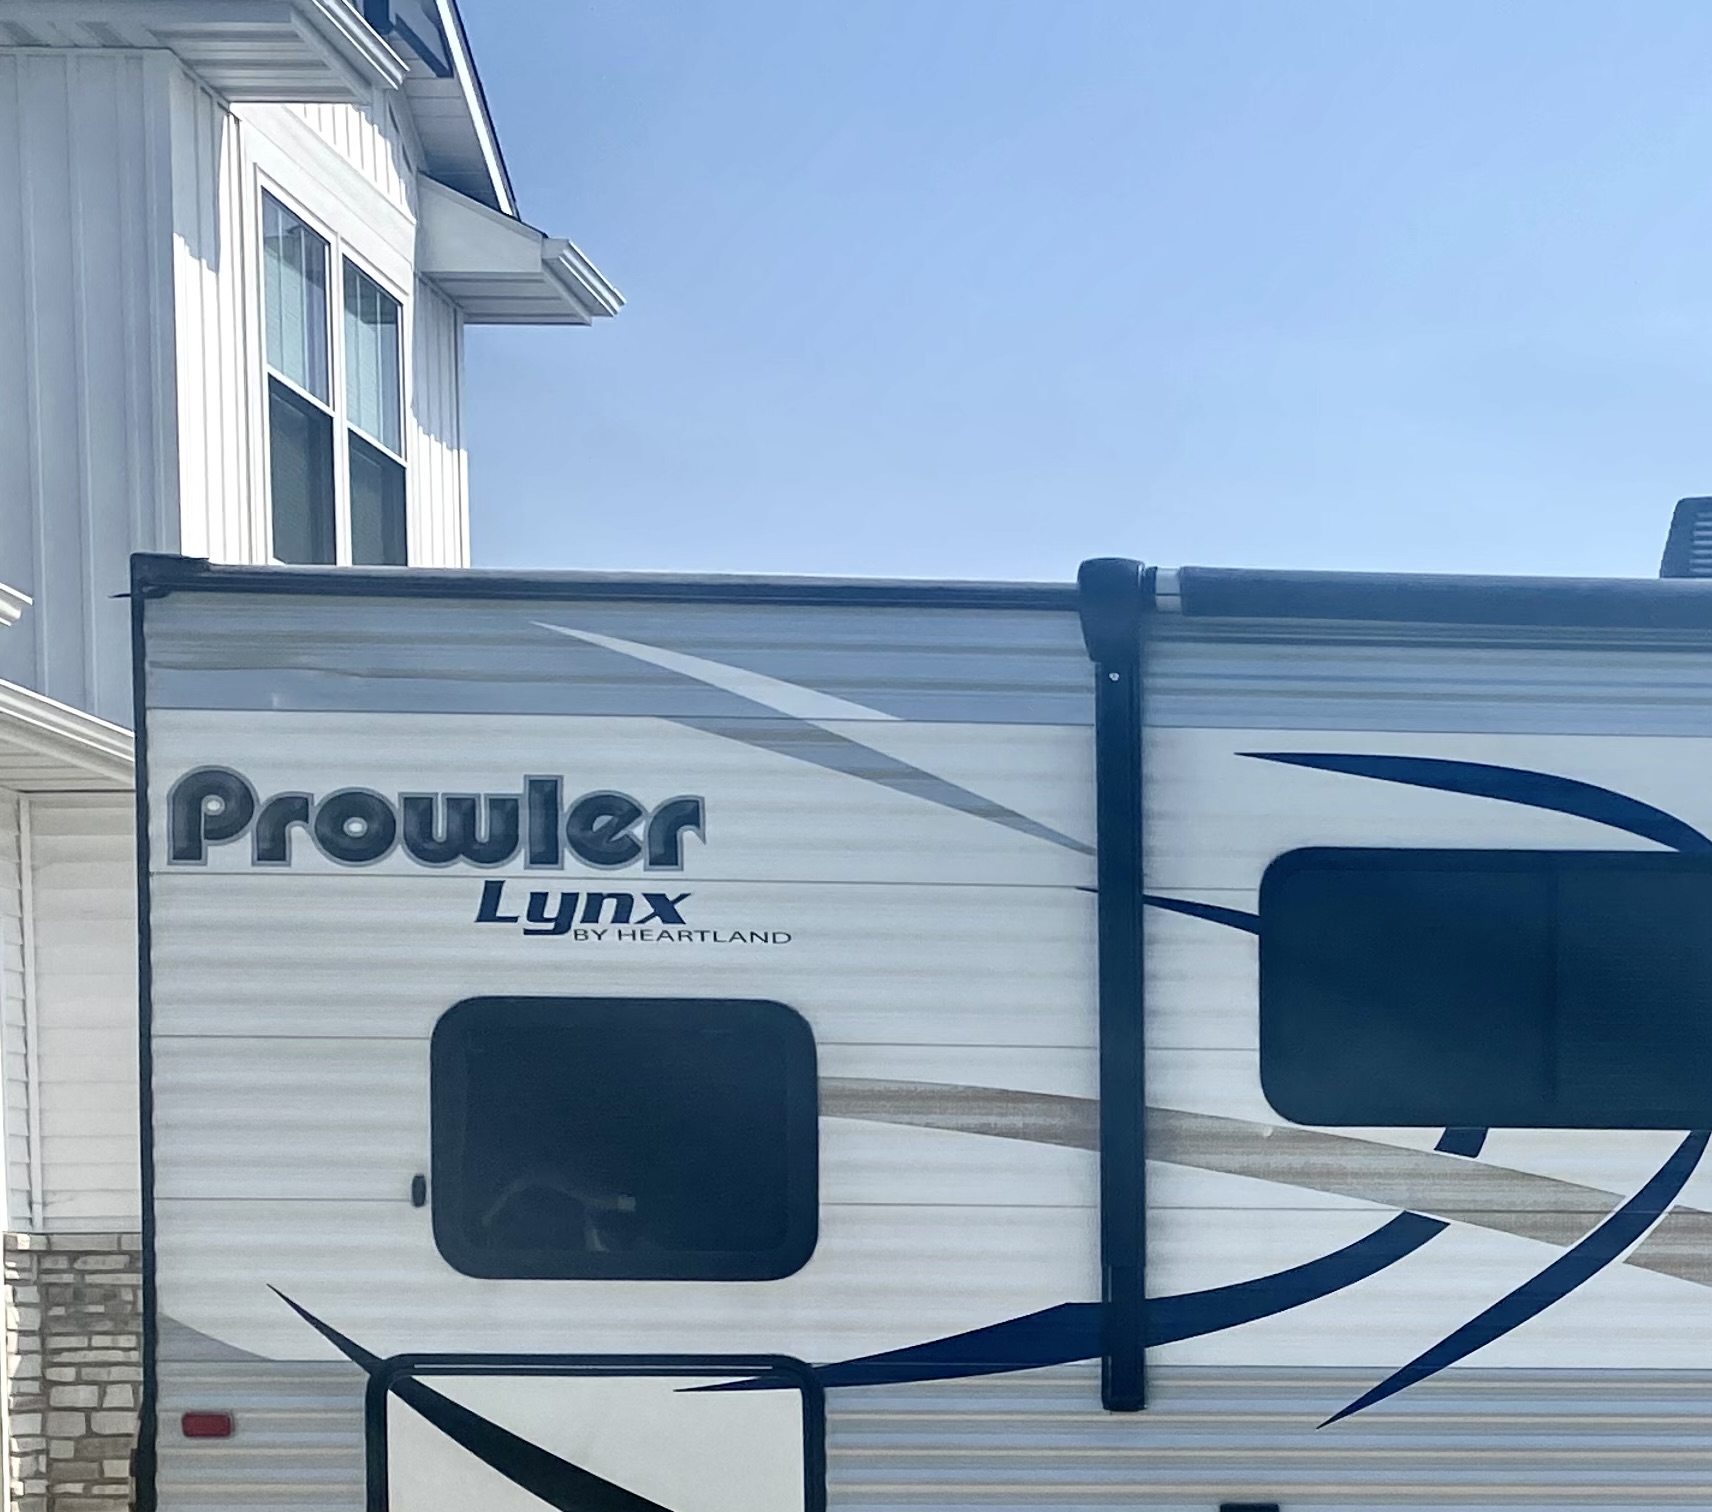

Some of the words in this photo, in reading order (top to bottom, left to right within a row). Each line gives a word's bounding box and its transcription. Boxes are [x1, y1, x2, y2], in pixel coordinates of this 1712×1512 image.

[166, 764, 706, 871] Prowler
[474, 880, 692, 936] Lynx
[573, 928, 608, 942] BY
[617, 928, 793, 945] HEARTLAND
